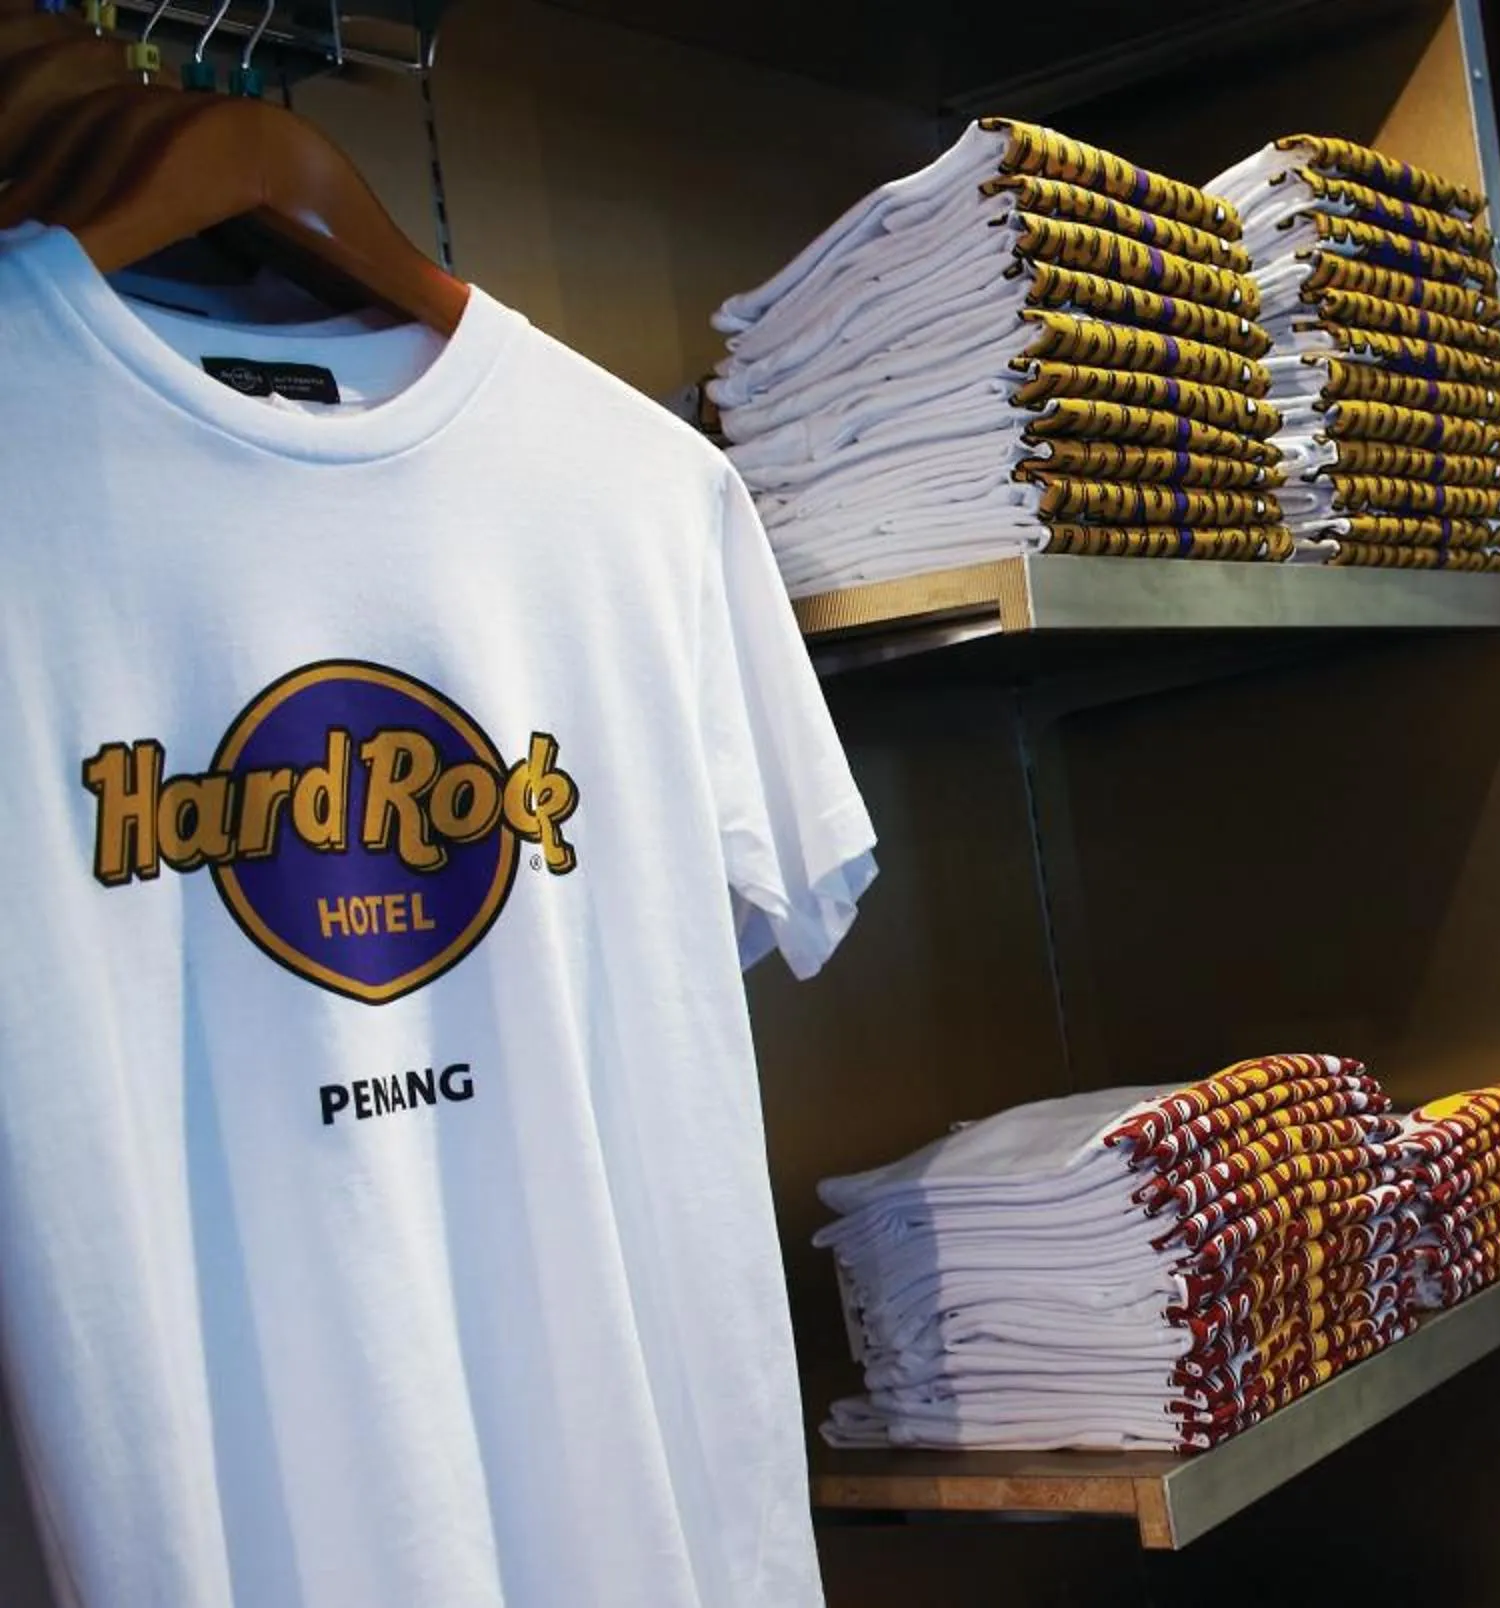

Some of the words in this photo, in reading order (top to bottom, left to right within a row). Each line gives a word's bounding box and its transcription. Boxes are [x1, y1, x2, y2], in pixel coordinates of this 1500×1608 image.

[82, 726, 350, 887] Hard
[317, 893, 436, 938] HOTEL
[319, 1063, 475, 1125] PENANG
